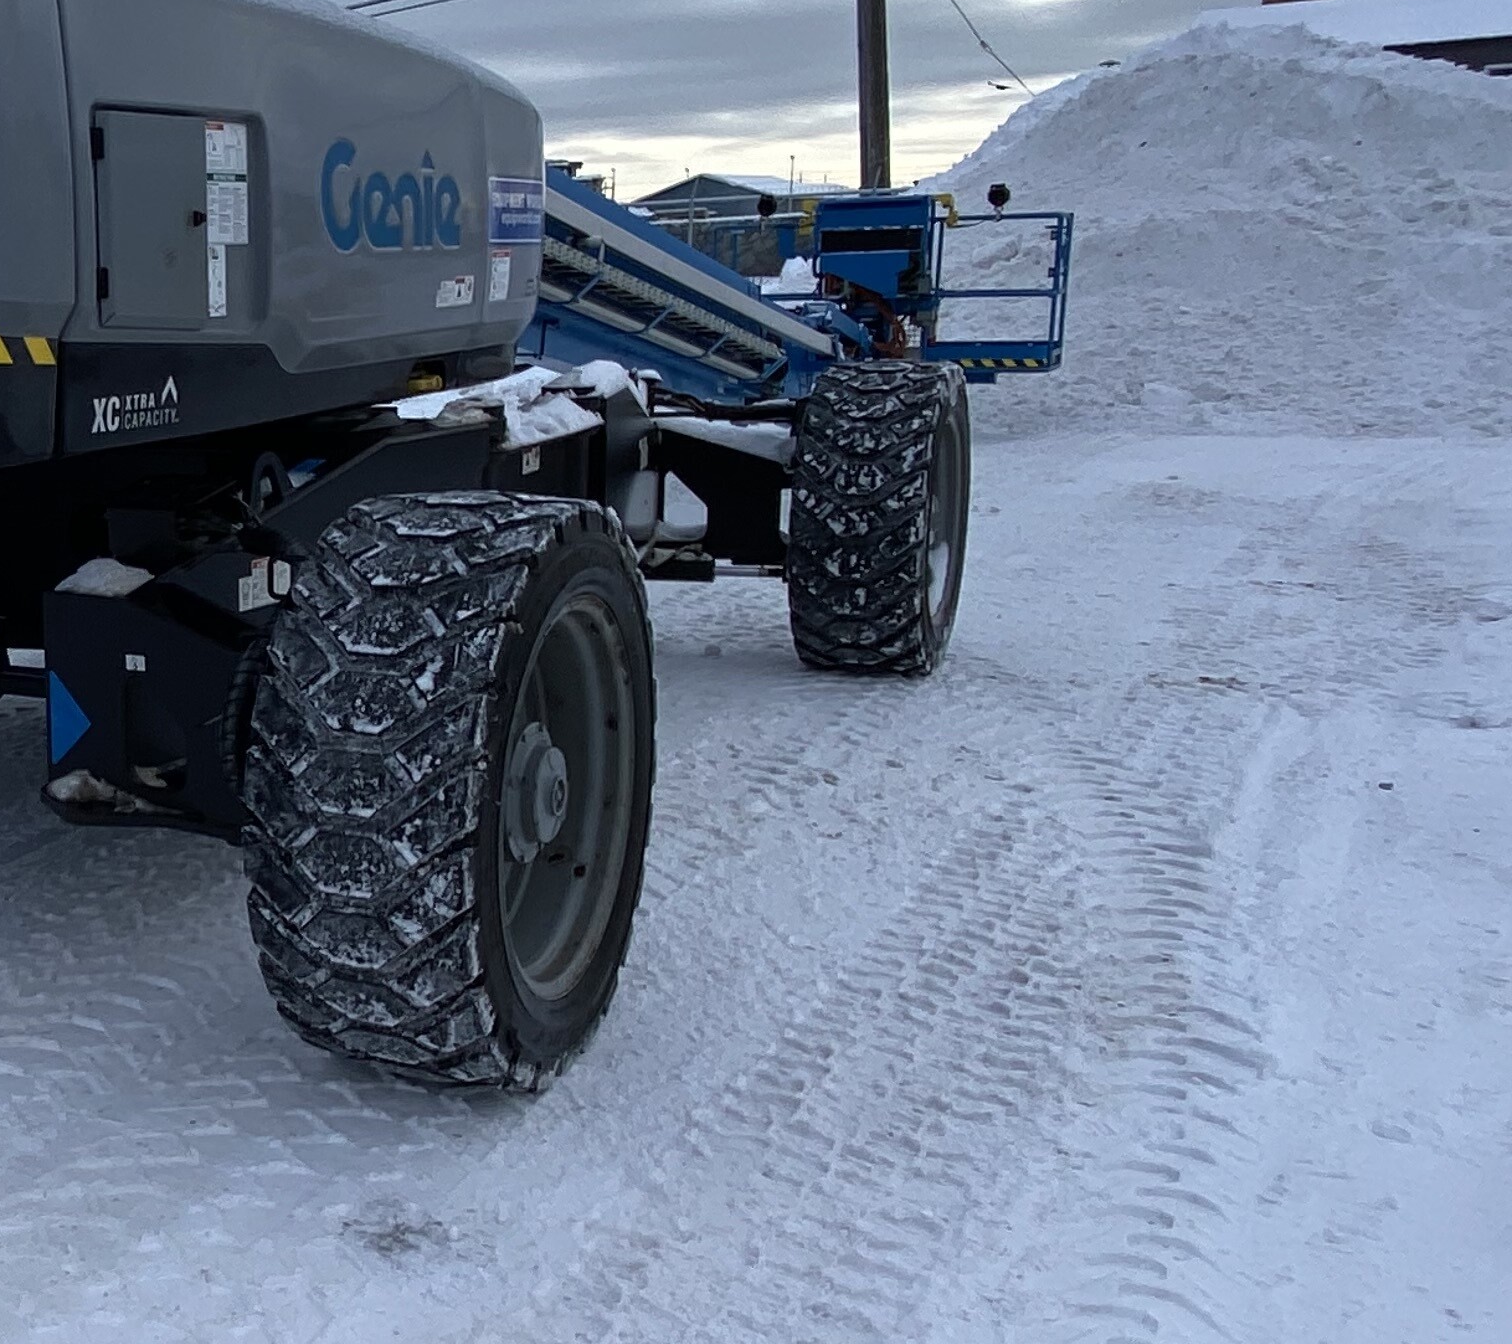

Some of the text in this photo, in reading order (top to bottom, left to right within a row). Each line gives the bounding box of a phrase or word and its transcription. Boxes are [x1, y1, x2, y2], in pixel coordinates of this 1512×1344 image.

[320, 136, 461, 254] Genie
[91, 395, 121, 434] XC
[125, 392, 156, 411] XTRA
[124, 408, 178, 430] CAPACITY
